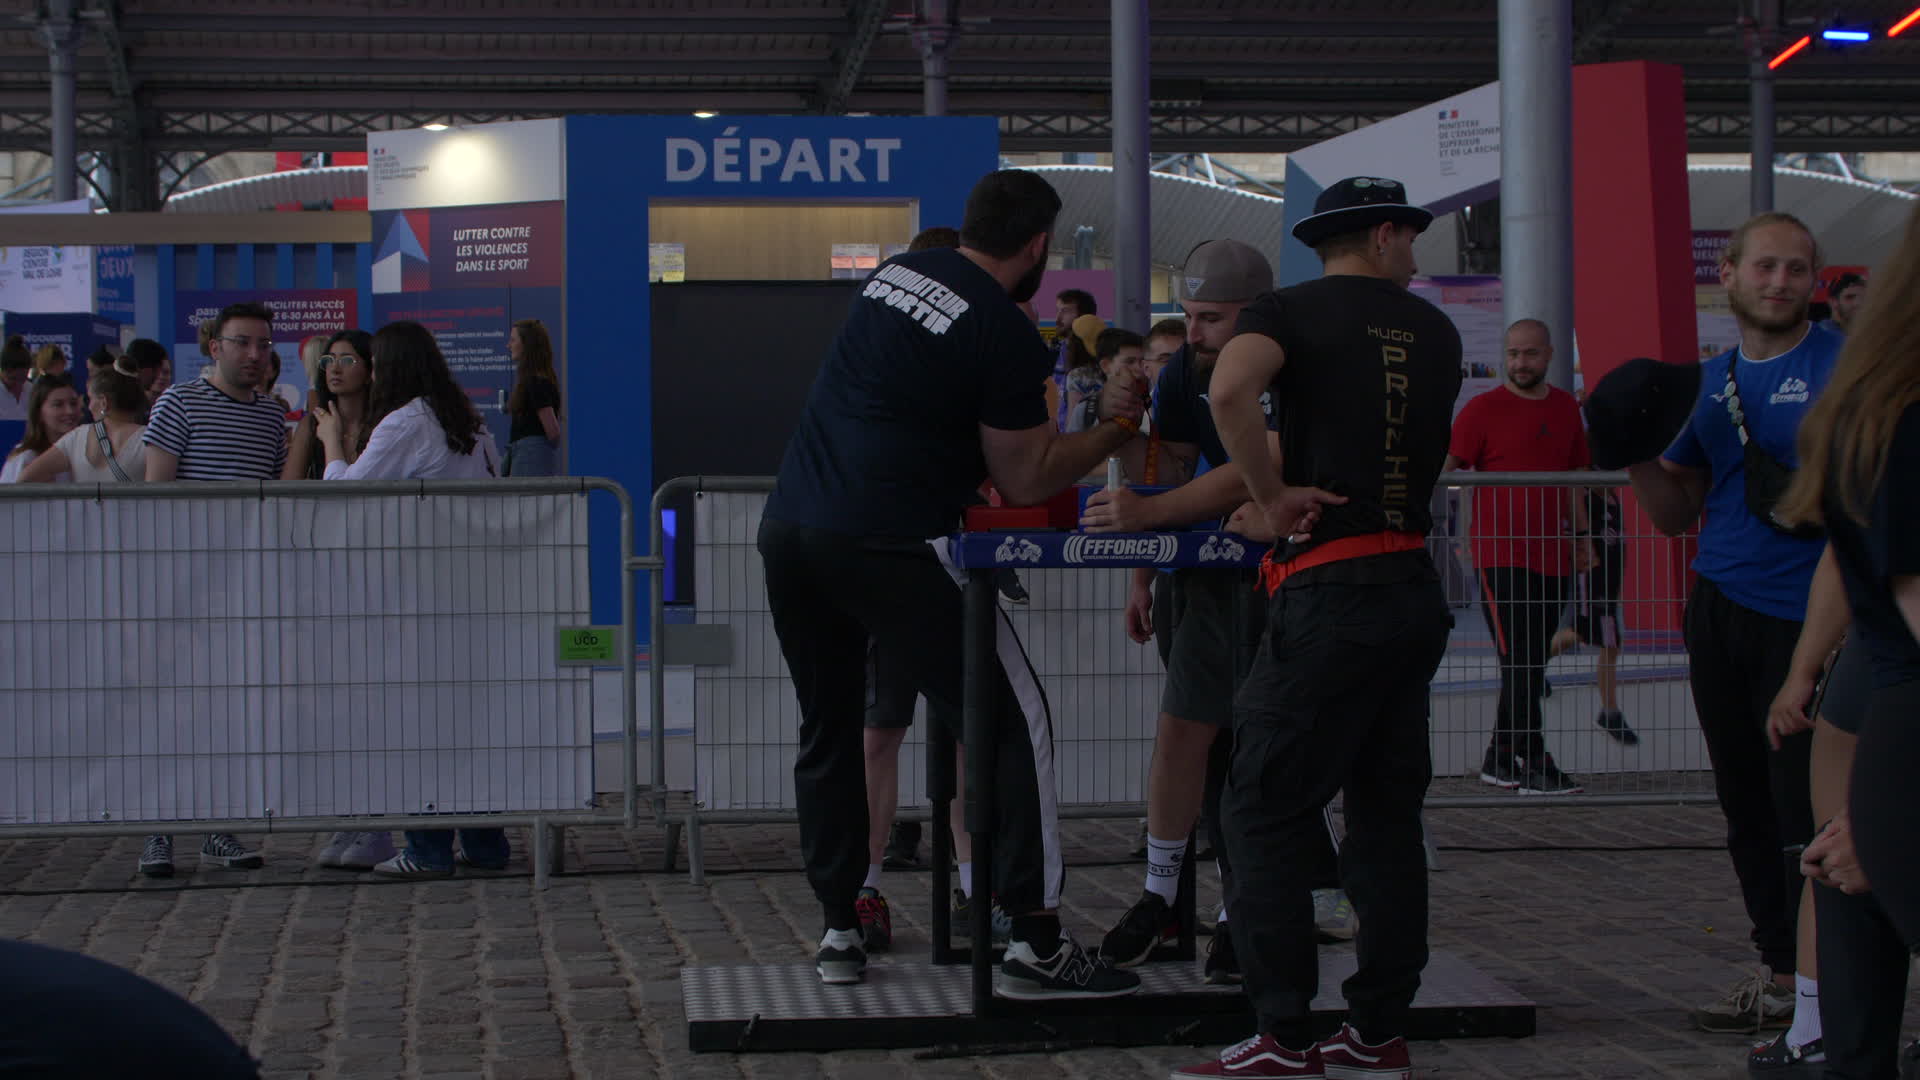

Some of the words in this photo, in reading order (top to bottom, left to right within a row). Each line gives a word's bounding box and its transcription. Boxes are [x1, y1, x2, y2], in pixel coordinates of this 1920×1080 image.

[665, 126, 902, 182] DÉPART
[453, 228, 489, 241] LUTTER
[490, 226, 532, 240] CONTRE
[456, 244, 473, 257] LES
[474, 242, 529, 256] VIOLENCES
[455, 260, 483, 273] DANS
[484, 259, 496, 271] LE
[497, 258, 529, 271] SPORT
[873, 263, 970, 321] ANIMATEUR
[309, 299, 345, 310] L'ACCÈS
[862, 280, 953, 336] SPORTIF
[302, 311, 322, 320] ANS
[332, 311, 345, 320] LA
[272, 321, 300, 332] TIQUE
[301, 321, 345, 331] SPORTIVE
[1367, 325, 1415, 344] HUGO
[1083, 538, 1160, 556] FFFORCE
